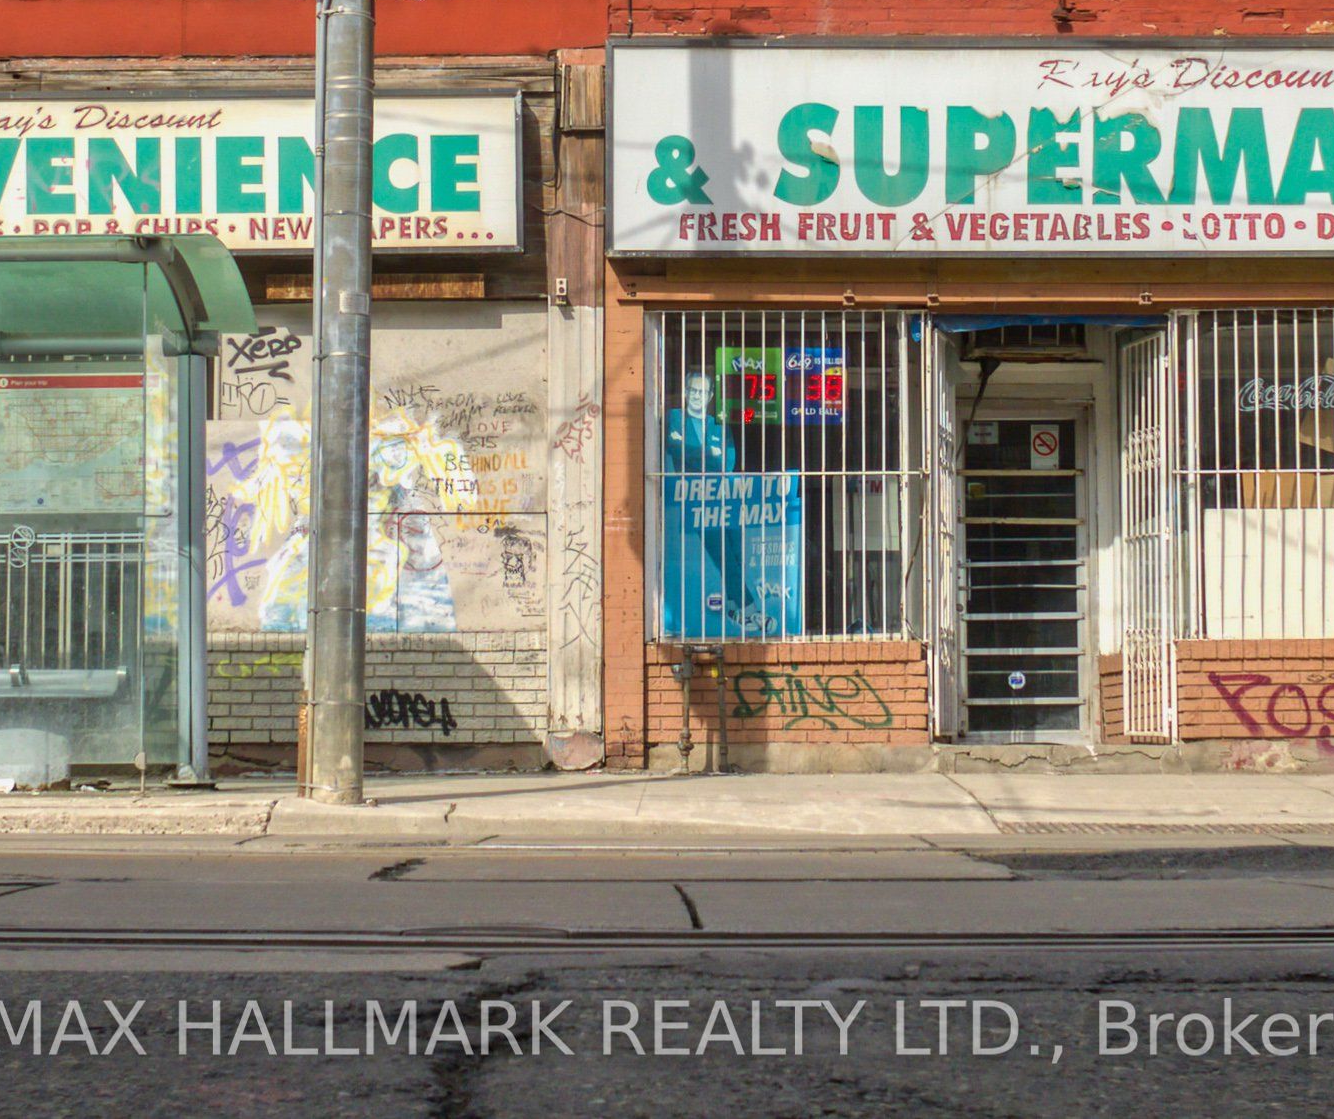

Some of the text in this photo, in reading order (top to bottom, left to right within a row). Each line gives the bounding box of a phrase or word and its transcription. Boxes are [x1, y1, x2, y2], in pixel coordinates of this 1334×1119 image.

[74, 104, 224, 130] Discount
[647, 134, 714, 206] &
[33, 219, 93, 236] POP
[135, 218, 219, 236] CHIPS
[679, 212, 781, 241] FRESH
[797, 212, 896, 241] FRUIT
[911, 212, 935, 241] &
[945, 212, 1151, 241] VEGETABLES
[744, 373, 777, 401] 75
[674, 475, 792, 502] DREAM TO
[691, 502, 789, 528] THE MAX
